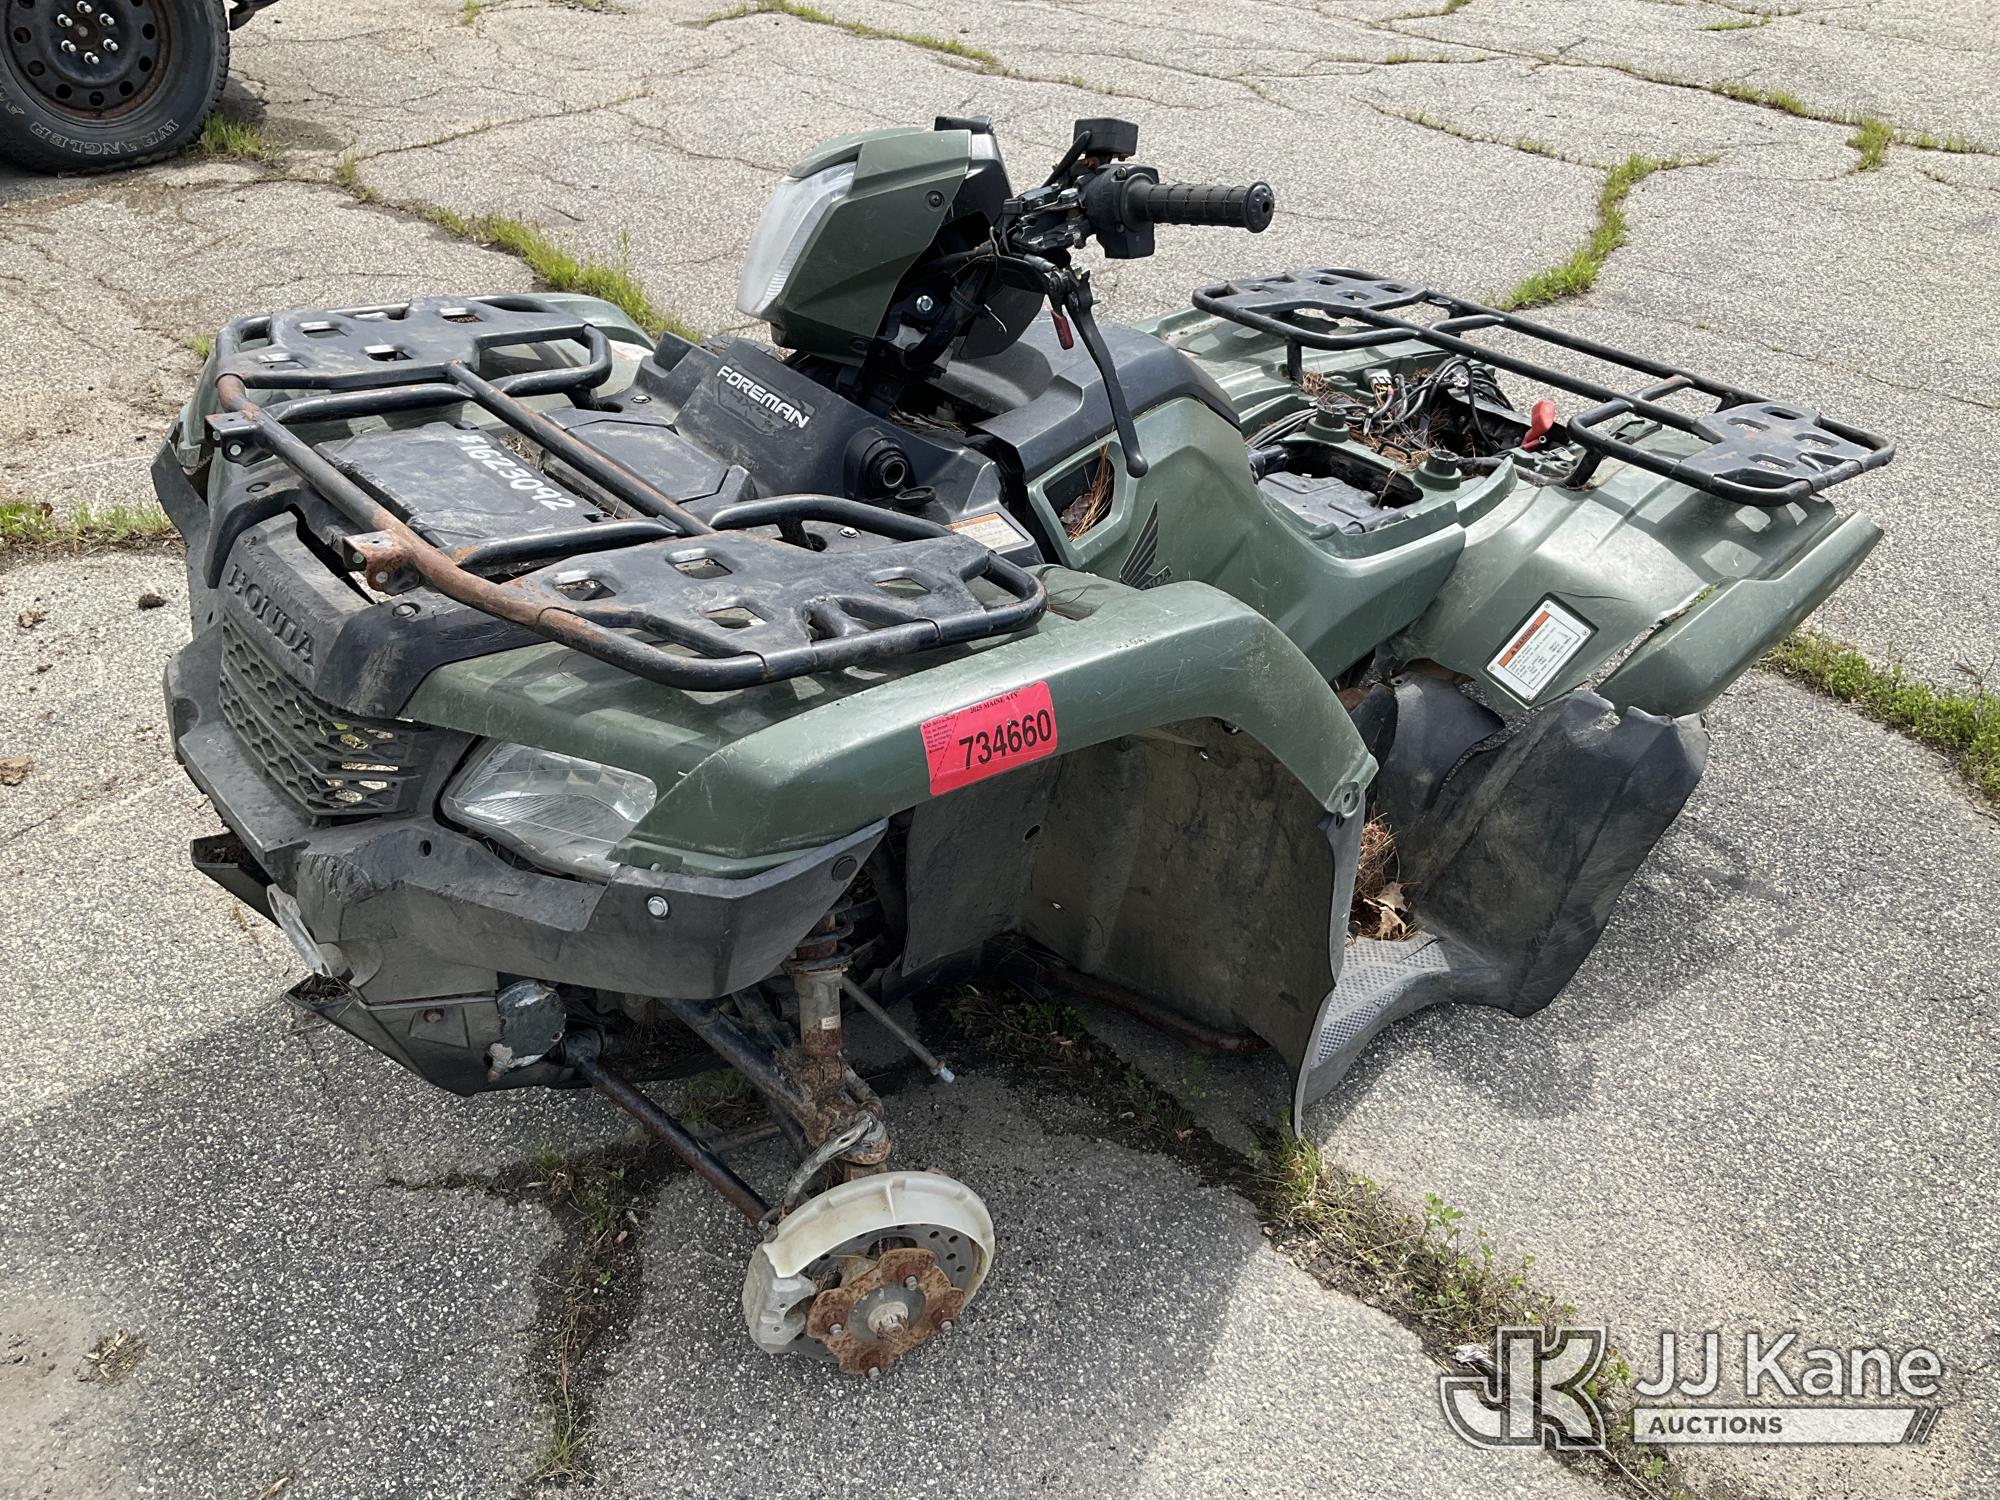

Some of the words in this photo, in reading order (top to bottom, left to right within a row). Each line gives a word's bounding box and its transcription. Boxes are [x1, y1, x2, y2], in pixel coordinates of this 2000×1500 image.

[29, 119, 181, 155] WRANGLER
[716, 365, 811, 429] FOREMAN
[456, 434, 577, 511] #1623092
[227, 563, 315, 668] HONDA
[958, 709, 1052, 770] 734660
